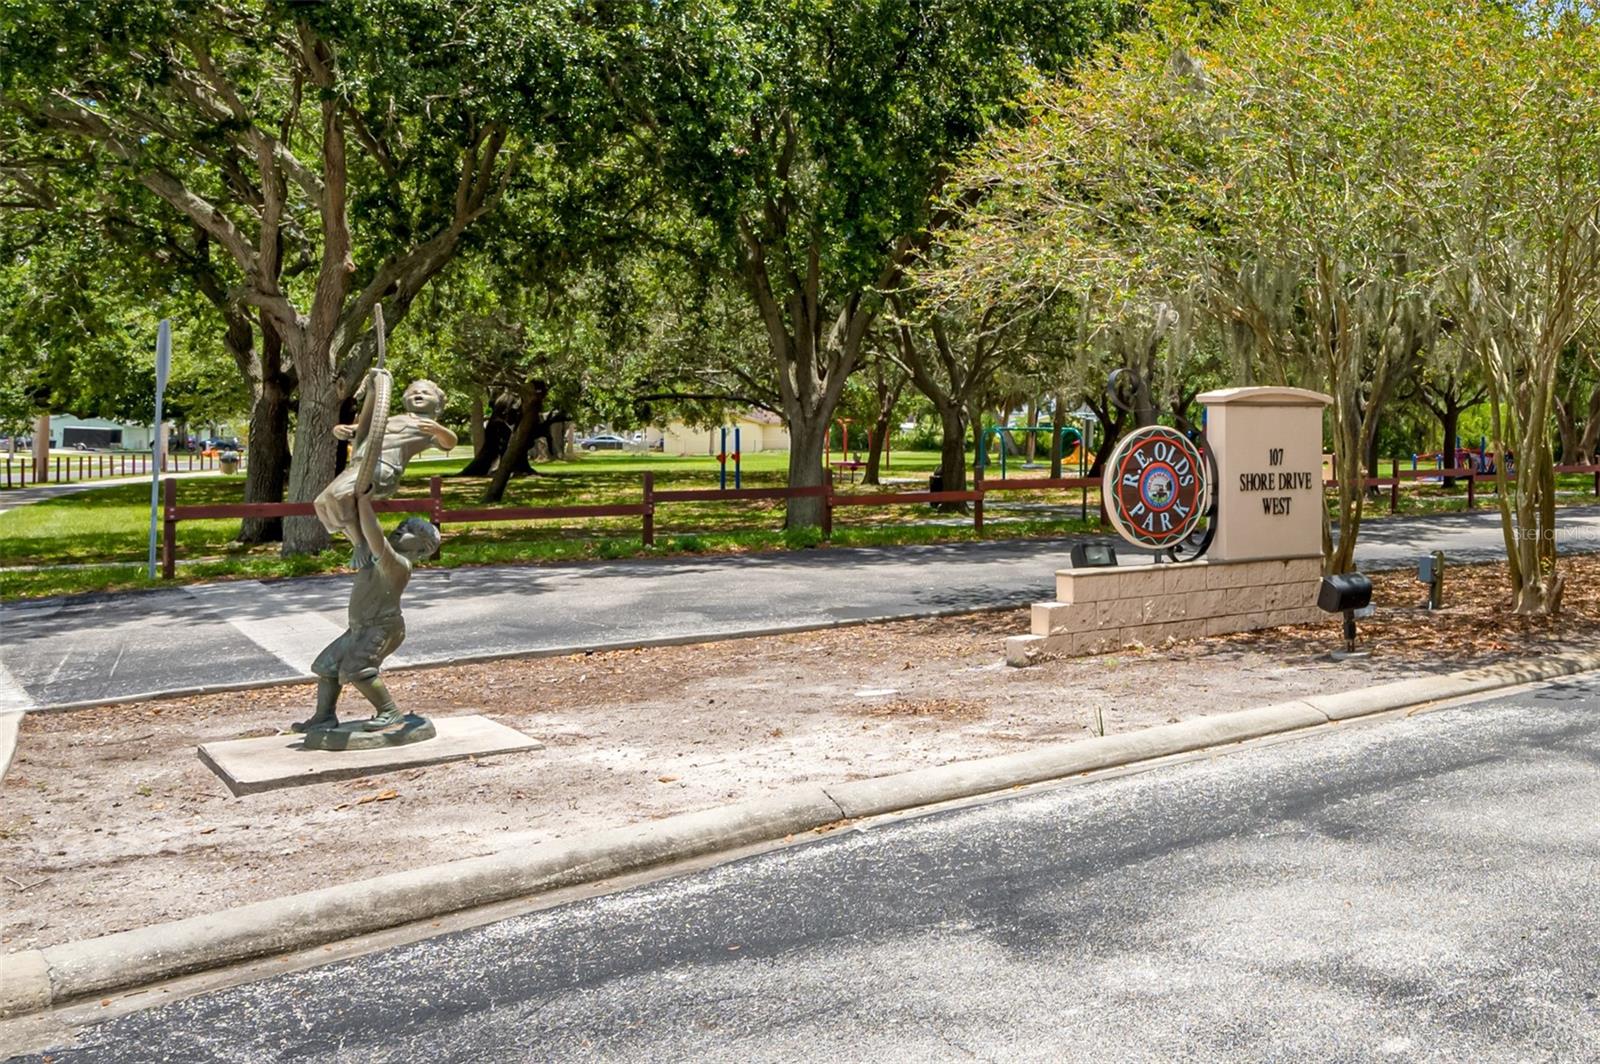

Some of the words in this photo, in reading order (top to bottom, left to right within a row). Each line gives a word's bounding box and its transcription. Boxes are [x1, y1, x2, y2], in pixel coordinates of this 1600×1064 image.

[1269, 448, 1284, 466] 107
[1240, 473, 1275, 492] SHORE
[1279, 472, 1312, 490] DRIVE
[1129, 499, 1190, 532] PARK
[1262, 497, 1292, 516] WEST
